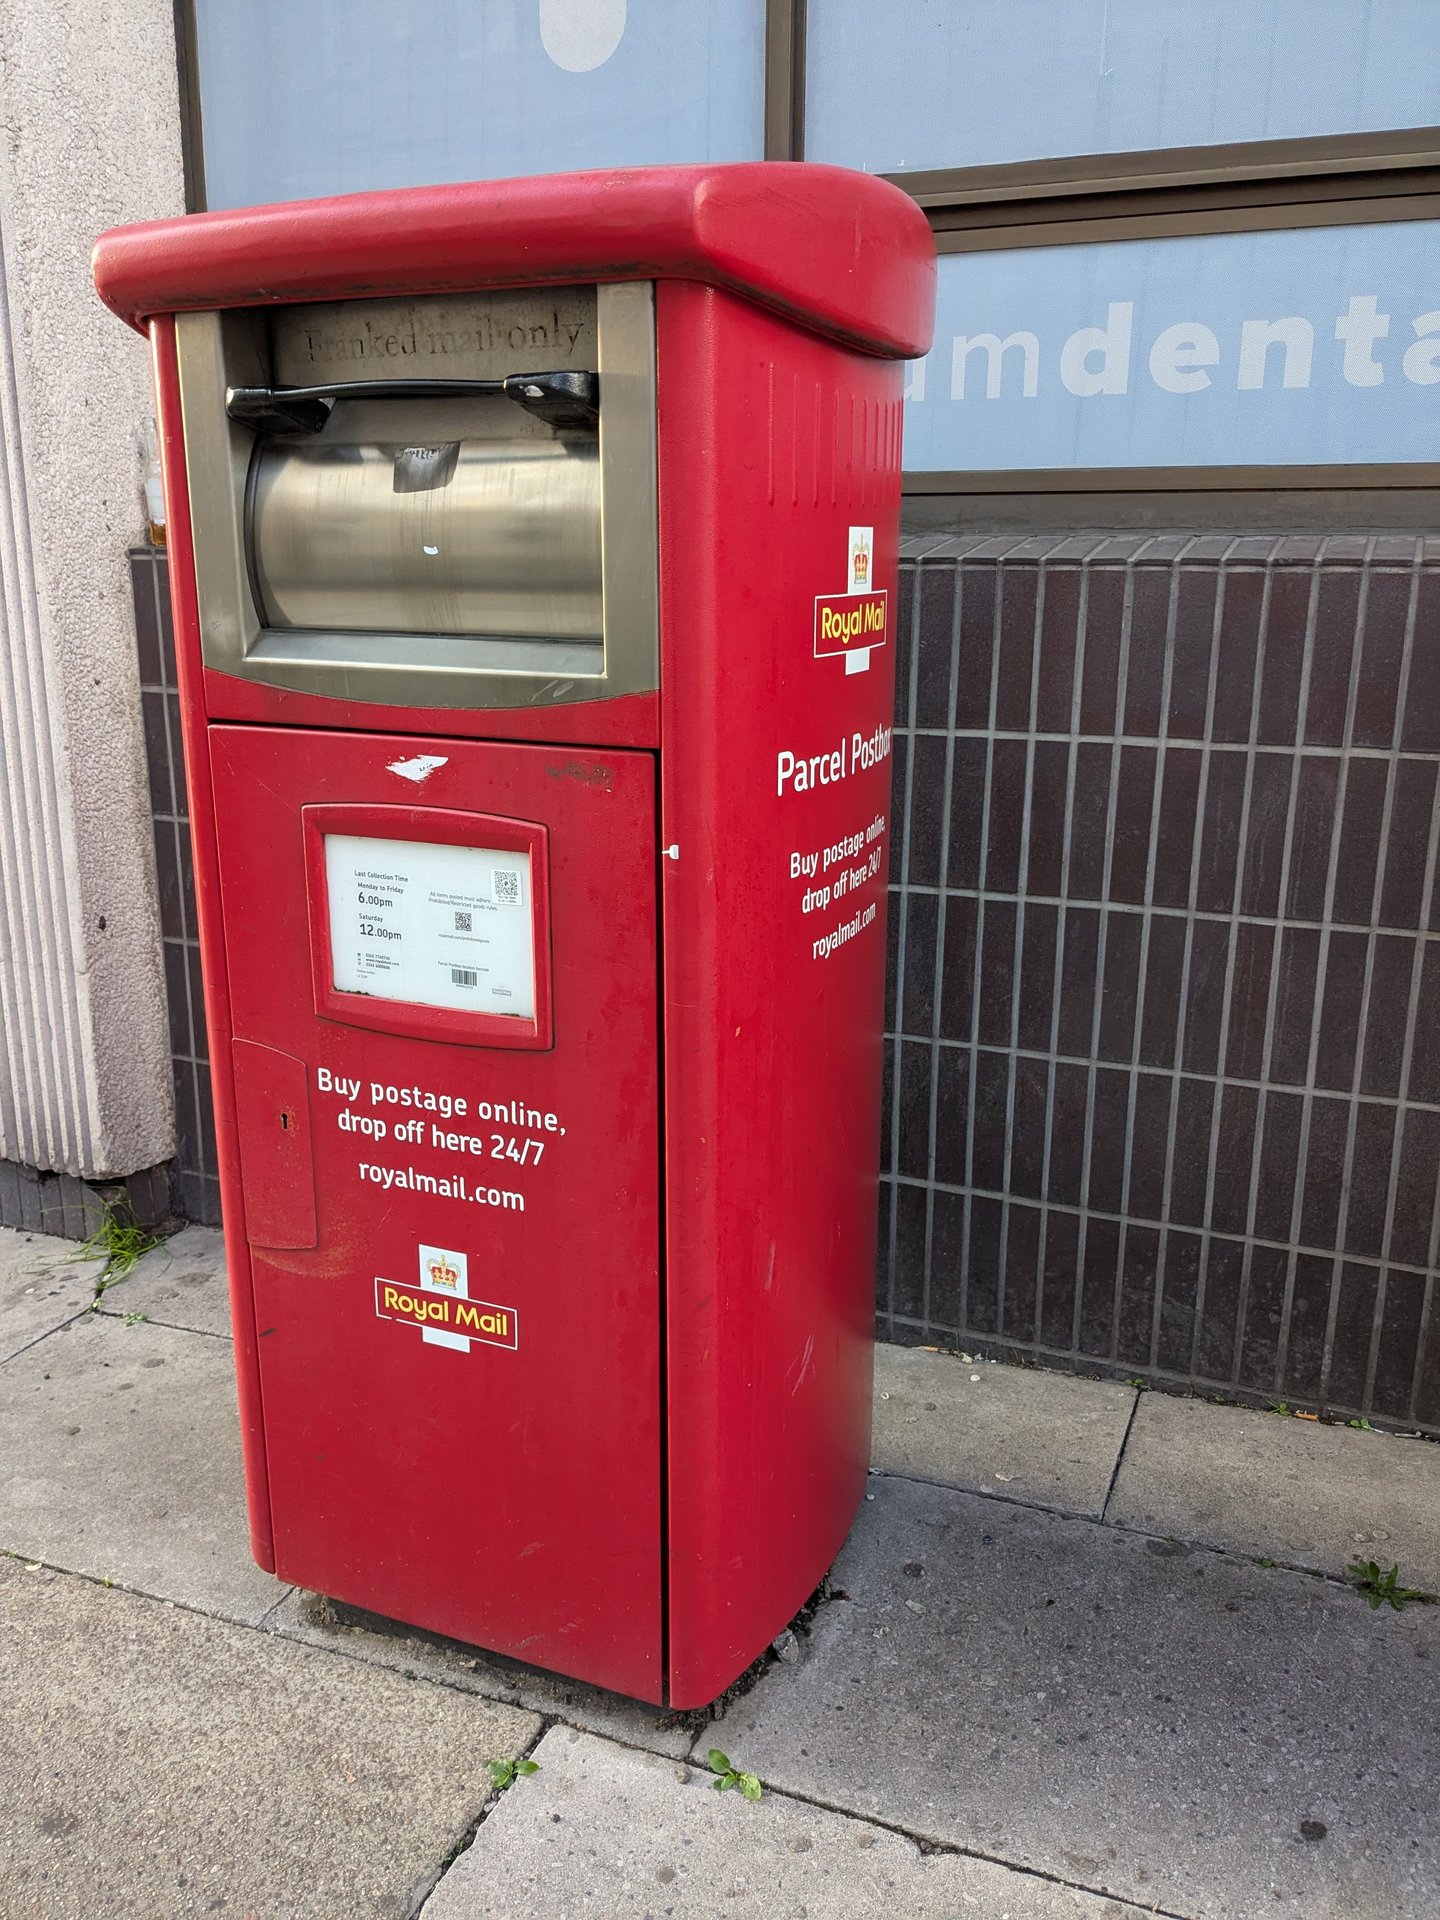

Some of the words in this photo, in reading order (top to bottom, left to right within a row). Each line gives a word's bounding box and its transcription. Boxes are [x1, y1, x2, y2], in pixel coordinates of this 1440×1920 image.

[304, 316, 417, 362] Franked
[428, 312, 496, 354] mail
[507, 310, 584, 356] only
[821, 606, 862, 644] Royal
[864, 601, 885, 634] Mail
[777, 737, 846, 796] Parcel
[851, 722, 892, 776] Postbox
[790, 852, 819, 879] Buy
[823, 831, 864, 872] postage
[866, 814, 886, 844] online,
[354, 869, 367, 878] Last
[367, 871, 393, 881] Collection
[394, 874, 408, 882] Time
[357, 881, 378, 892] Monday
[386, 885, 404, 894] Friday
[357, 891, 393, 907] 6.00pm
[476, 896, 491, 904] adhere
[802, 887, 831, 914] drop
[834, 869, 848, 900] off
[849, 863, 867, 892] here
[868, 846, 882, 878] 24/7
[358, 912, 383, 923] Saturday
[359, 923, 402, 940] 12.00pm
[812, 902, 876, 960] royalmail.com
[317, 1067, 361, 1101] Buy
[370, 1082, 467, 1118] postage
[478, 1101, 567, 1136] online,
[337, 1109, 387, 1141] drop
[394, 1120, 425, 1144] off
[432, 1124, 482, 1155] here
[490, 1134, 545, 1166] 24/7
[358, 1162, 526, 1211] royalmail.com
[384, 1286, 449, 1322] Royal
[455, 1303, 508, 1336] Mail
